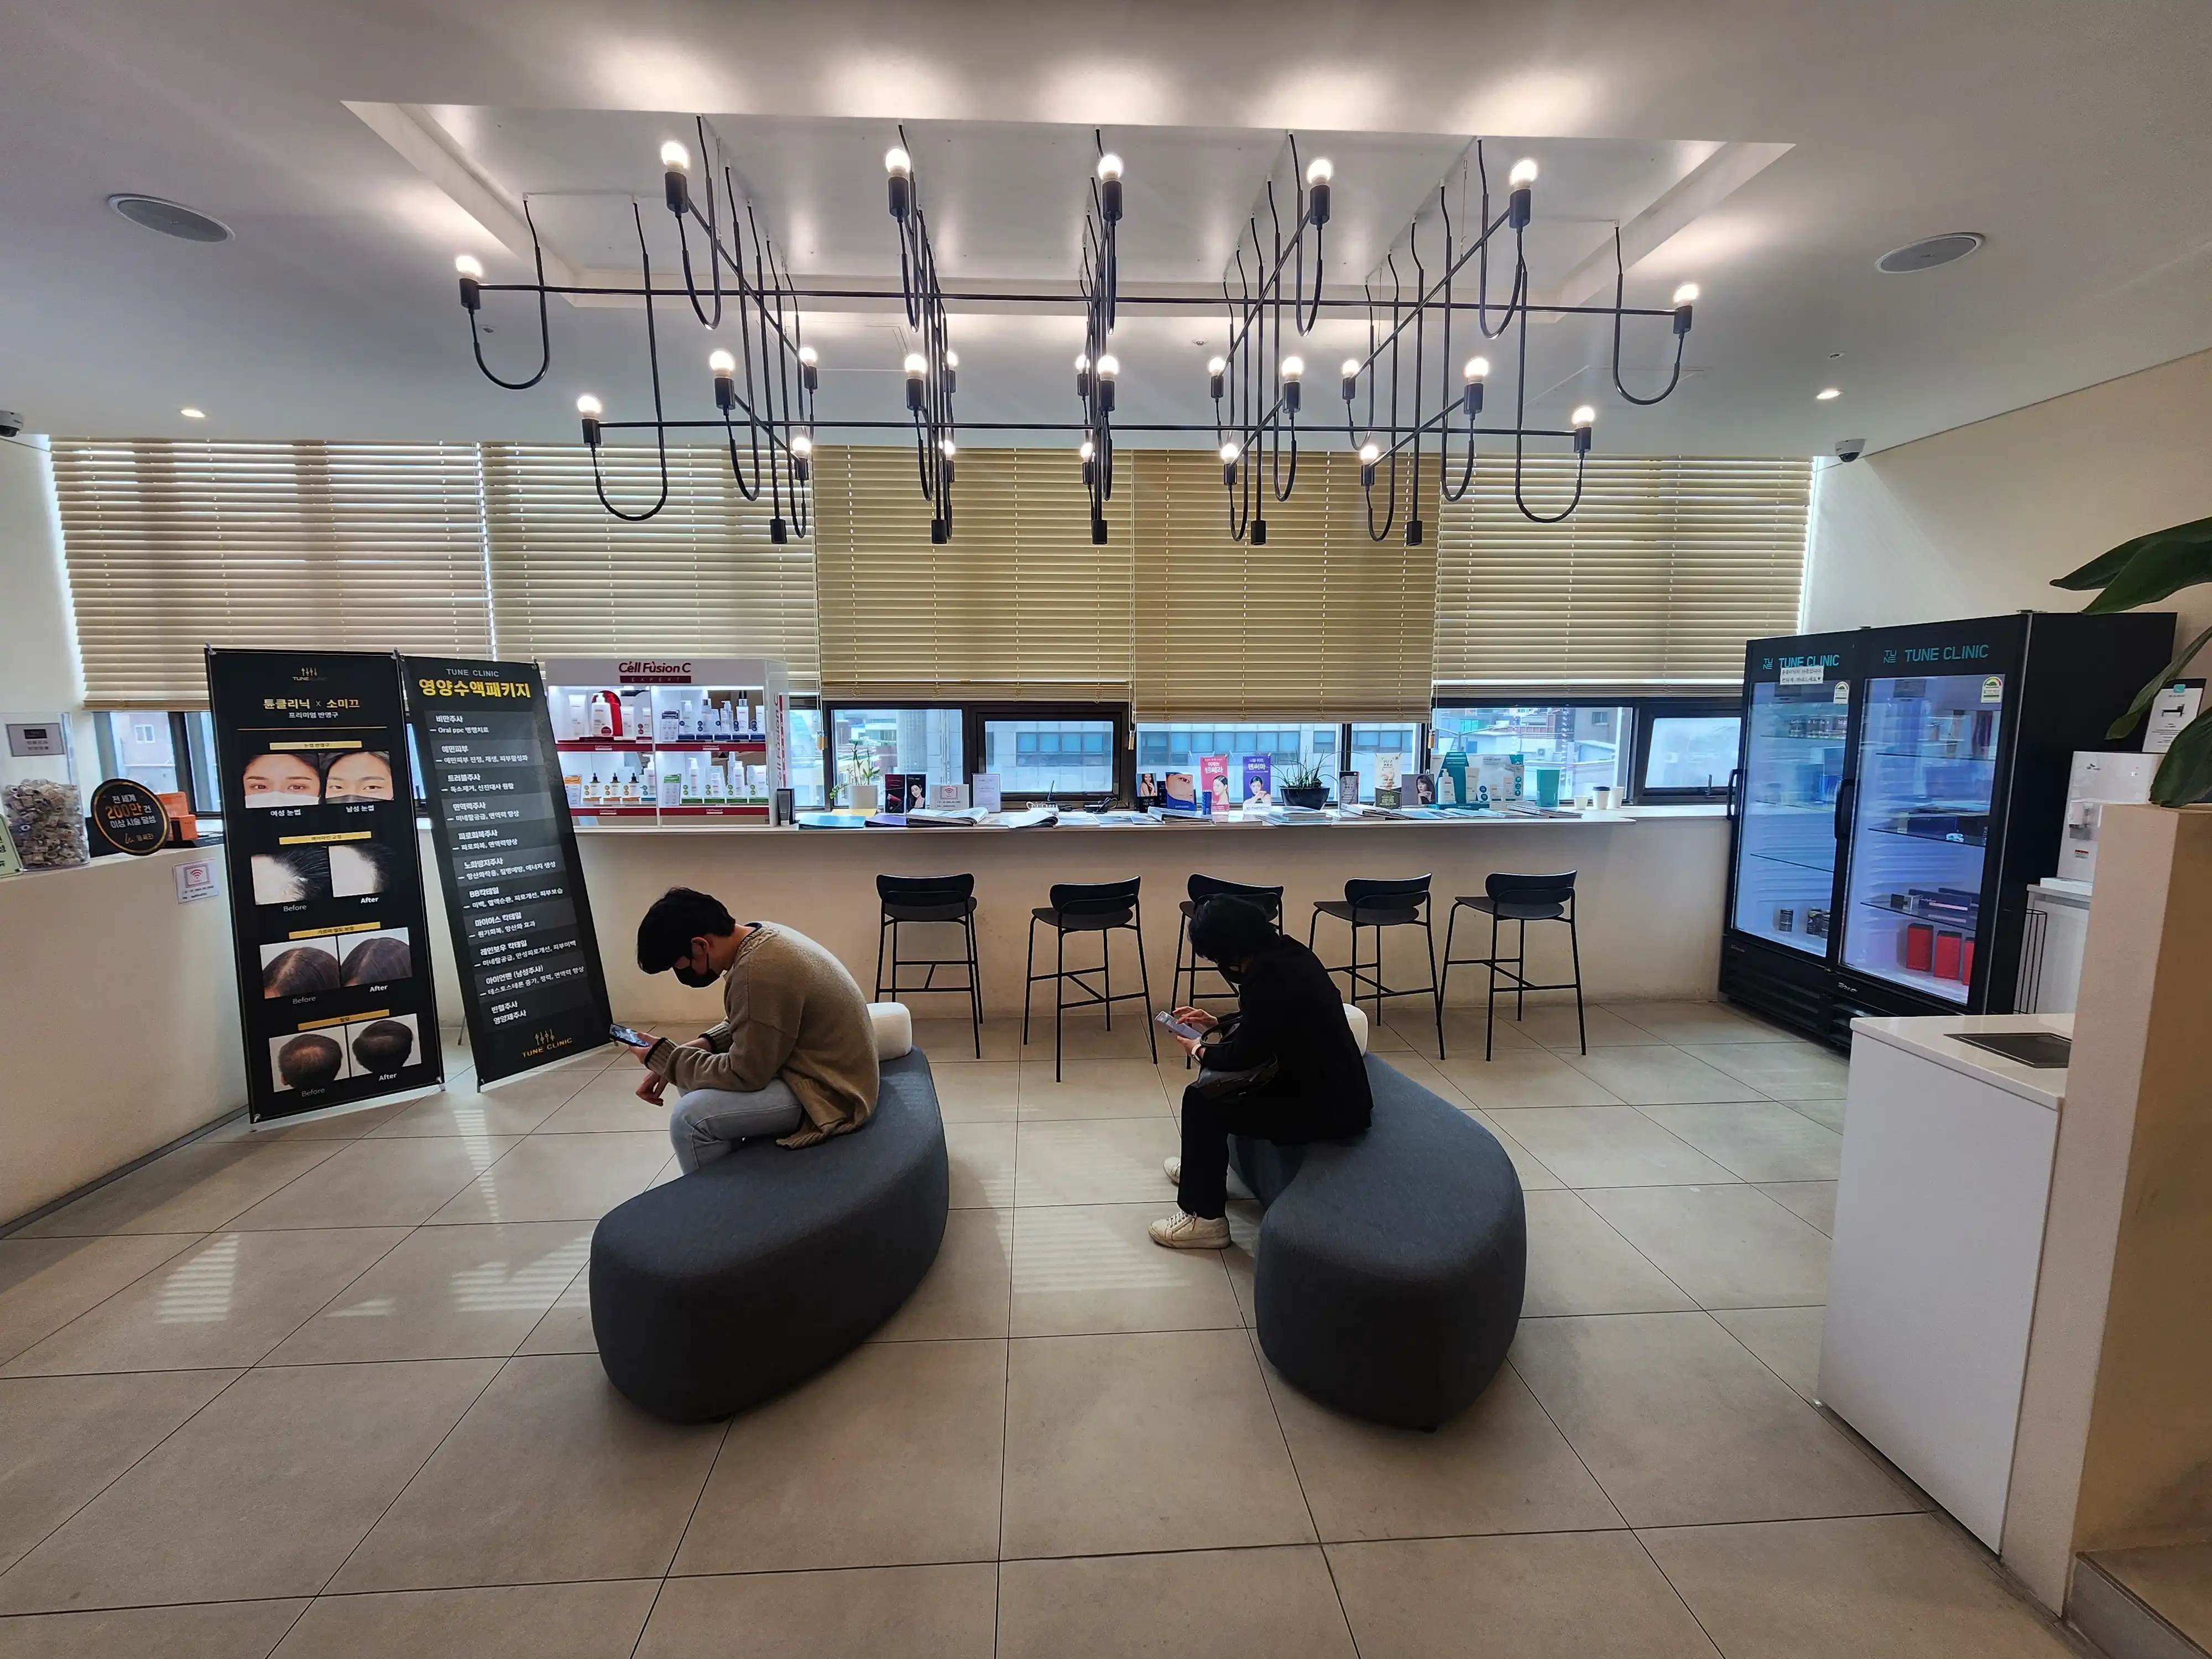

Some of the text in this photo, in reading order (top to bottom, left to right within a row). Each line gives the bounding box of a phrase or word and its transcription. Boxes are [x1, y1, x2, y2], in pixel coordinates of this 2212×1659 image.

[1905, 644, 1990, 662] TUNE CLINIC
[1778, 654, 1840, 669] TUNE CLINIC
[682, 662, 691, 673] C
[419, 679, 531, 698] 영양수액패키지
[263, 698, 310, 709] 튠클리닉
[435, 715, 463, 723] 비만주사
[447, 774, 481, 782] 트러블주사
[112, 796, 122, 804] 전
[105, 802, 153, 820] 200만 건
[452, 802, 486, 811] 면역력주사
[110, 815, 156, 828] 이상 시술 달성
[458, 829, 498, 840] 피로회복주사
[464, 857, 504, 869] 노화방지주사
[525, 863, 544, 872] 에너지
[469, 886, 500, 899] BB칵테일
[524, 920, 536, 928] 효과
[480, 945, 507, 956] 레인보우
[513, 964, 544, 979] (남성주사)
[491, 1000, 518, 1014] 빈혈주사
[493, 1009, 527, 1025] 영양제주사
[521, 1037, 573, 1058] TUNE CLINIC
[378, 1073, 397, 1081] After
[301, 1088, 325, 1097] Before
